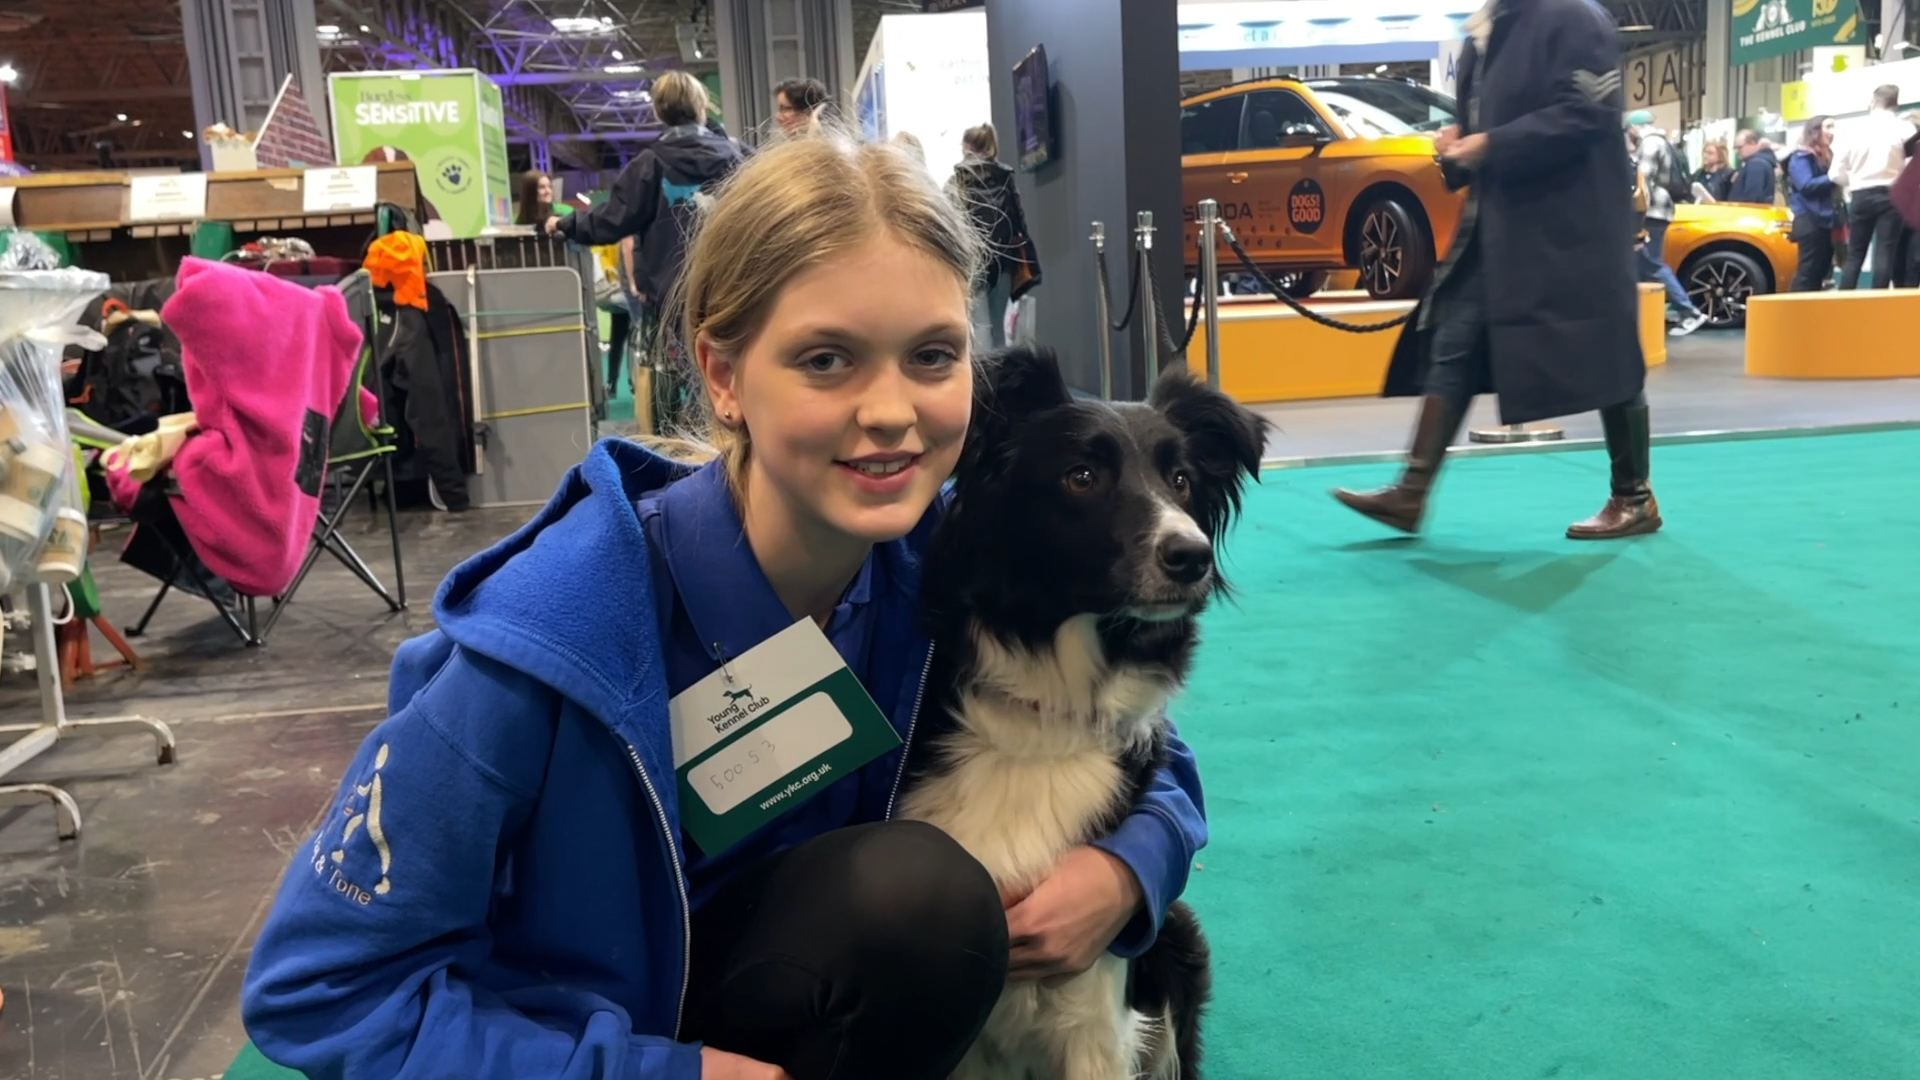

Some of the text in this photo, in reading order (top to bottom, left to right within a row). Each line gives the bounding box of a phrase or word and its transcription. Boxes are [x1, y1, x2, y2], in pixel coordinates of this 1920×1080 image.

[1292, 208, 1321, 223] GOOD
[707, 703, 740, 726] Young
[714, 694, 771, 734] Kennel Club
[759, 762, 832, 811] www.ykc.org.uk
